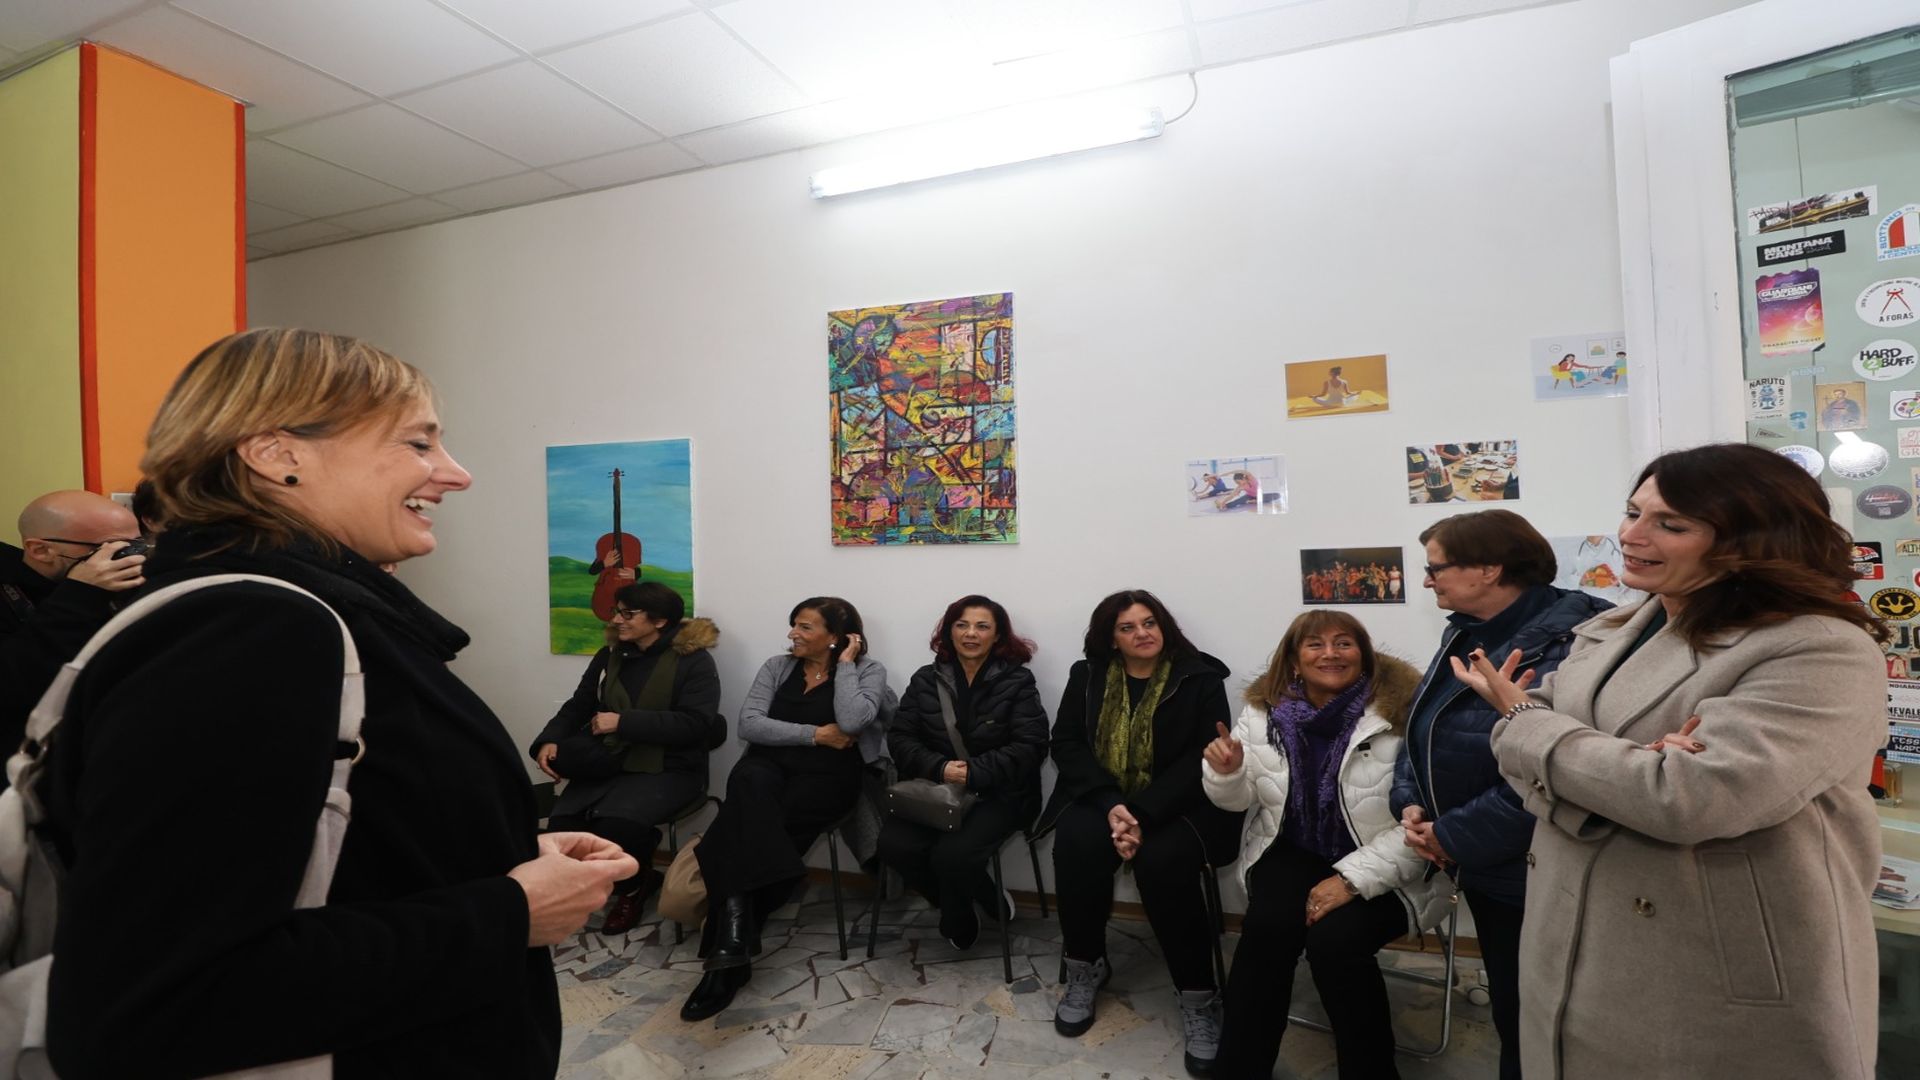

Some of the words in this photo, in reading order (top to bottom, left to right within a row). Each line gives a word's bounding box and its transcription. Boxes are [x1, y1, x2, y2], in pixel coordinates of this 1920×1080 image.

[1764, 236, 1833, 255] MONTANA
[1765, 249, 1805, 261] CANS
[1886, 312, 1914, 321] FORAS
[1860, 348, 1902, 361] HARD
[1881, 355, 1915, 367] BUFF.
[1749, 377, 1785, 388] NARUTO
